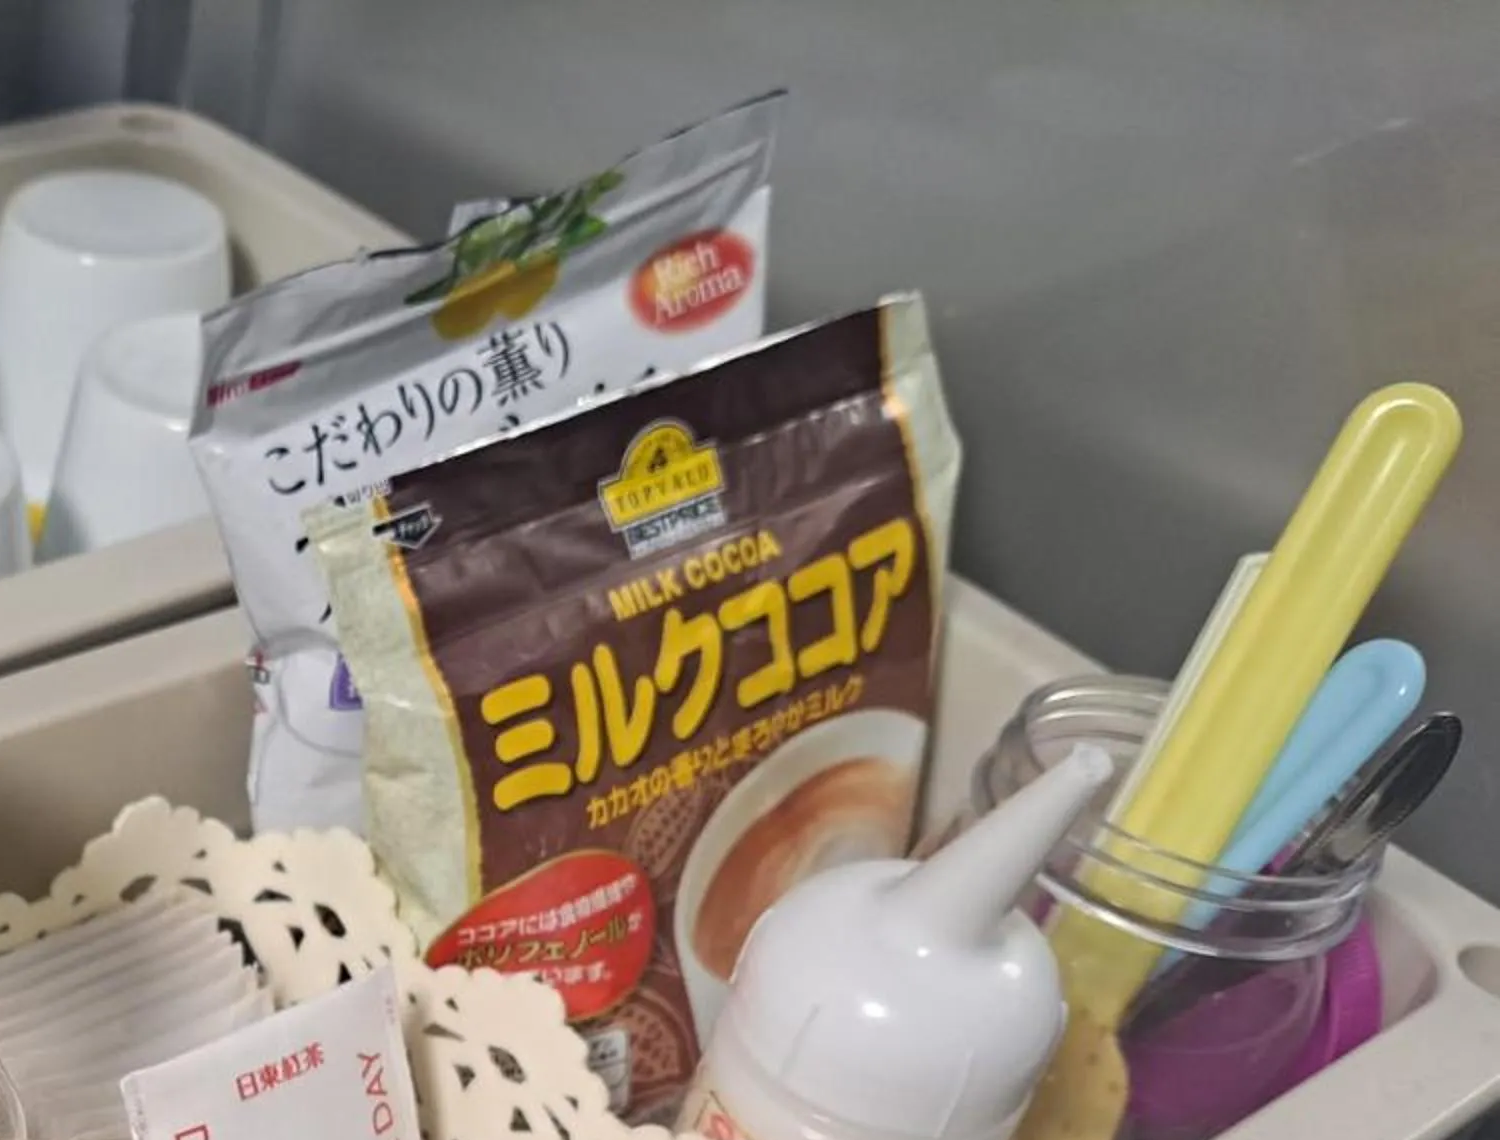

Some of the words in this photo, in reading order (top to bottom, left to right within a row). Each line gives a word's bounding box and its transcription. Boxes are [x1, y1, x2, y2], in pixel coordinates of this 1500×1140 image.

[655, 267, 743, 324] Aroma
[266, 320, 573, 496] こだわりの薫り
[608, 567, 683, 622] MILK
[684, 530, 782, 588] COCOA
[480, 518, 916, 811] ミルクココア
[235, 1041, 325, 1100] 日東紅茶
[356, 1051, 393, 1135] DAY
